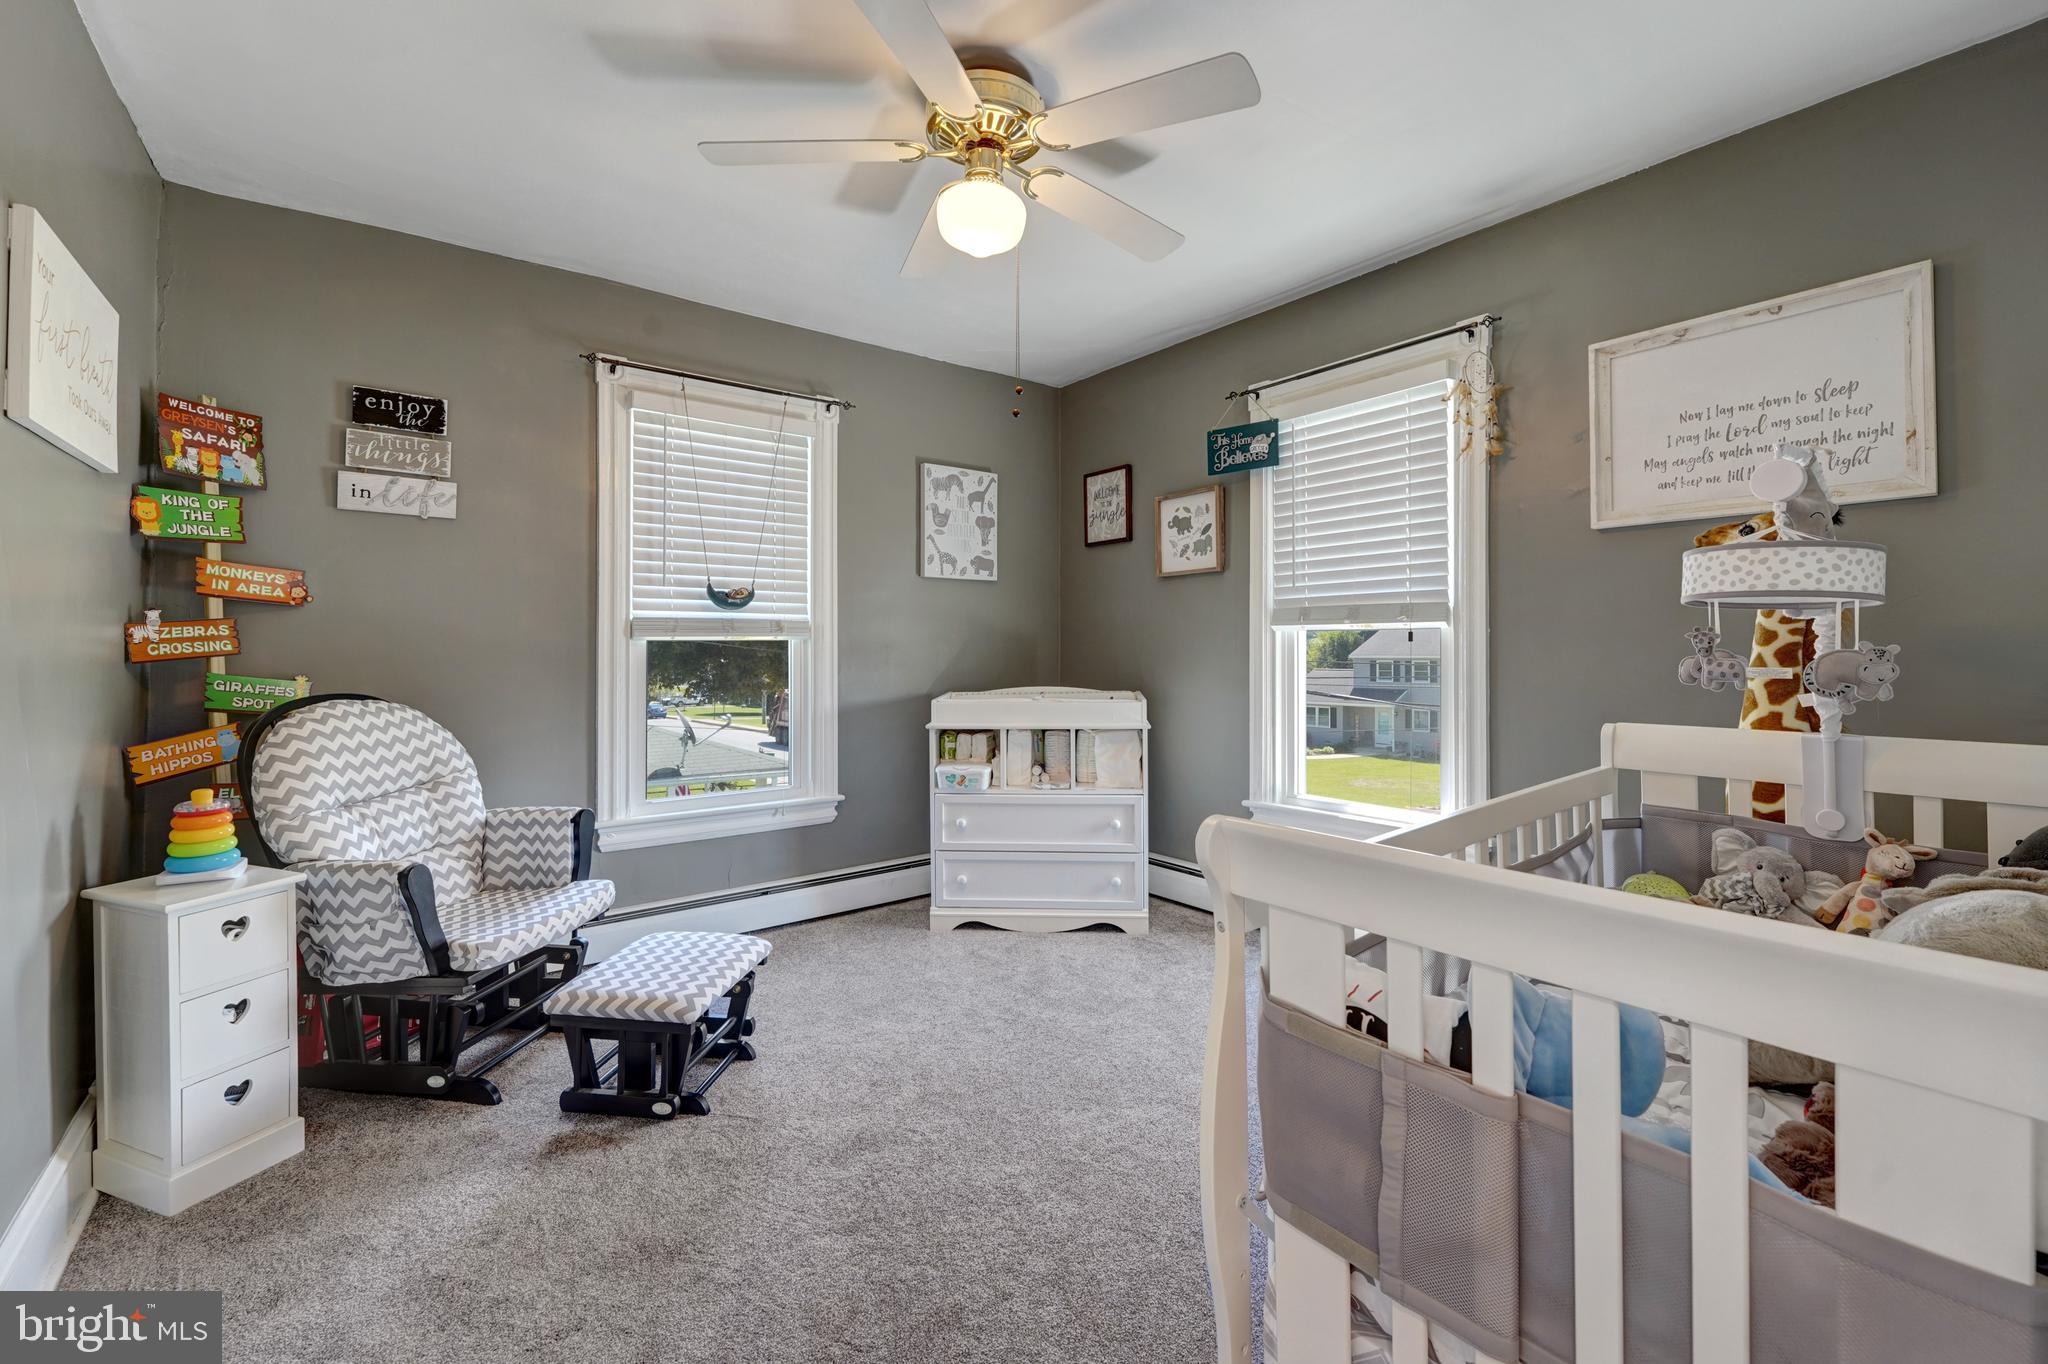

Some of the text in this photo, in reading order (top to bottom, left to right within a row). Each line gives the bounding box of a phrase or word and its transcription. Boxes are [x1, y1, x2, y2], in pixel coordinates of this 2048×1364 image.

[35, 290, 80, 368] first
[79, 326, 114, 403] breath
[168, 398, 256, 428] WELCOME TO
[365, 396, 436, 420] enjoy
[1679, 377, 1860, 425] Now I lay me down to sleep
[161, 408, 237, 436] GREYSEN'S
[396, 411, 430, 427] the
[1666, 403, 1873, 449] I pray the Lord my soul to keep
[181, 427, 247, 453] SAFARI
[379, 433, 431, 452] little
[1210, 432, 1230, 450] This
[1643, 421, 1895, 474] May angels watch me ough the night
[351, 440, 442, 472] things
[1213, 445, 1268, 472] Believes
[1657, 476, 1678, 491] and
[1680, 475, 1703, 489] keep
[1705, 475, 1722, 485] me
[1727, 465, 1744, 484] till
[1828, 446, 1879, 475] light
[161, 493, 229, 510] KING OF
[351, 483, 372, 499] in
[365, 477, 457, 519] life
[179, 509, 214, 522] THE
[1089, 502, 1126, 528] jungle
[167, 523, 232, 537] JUNGLE
[206, 563, 287, 585] MONKEYS
[211, 578, 285, 597] IN AREA
[159, 624, 230, 639] ZEBRAS
[147, 640, 233, 656] CROSSING
[213, 680, 296, 698] GIRAFFES
[232, 697, 275, 710] SPOT
[141, 736, 217, 763] BATHING
[150, 751, 214, 776] HIPPOS
[219, 787, 243, 799] EL
